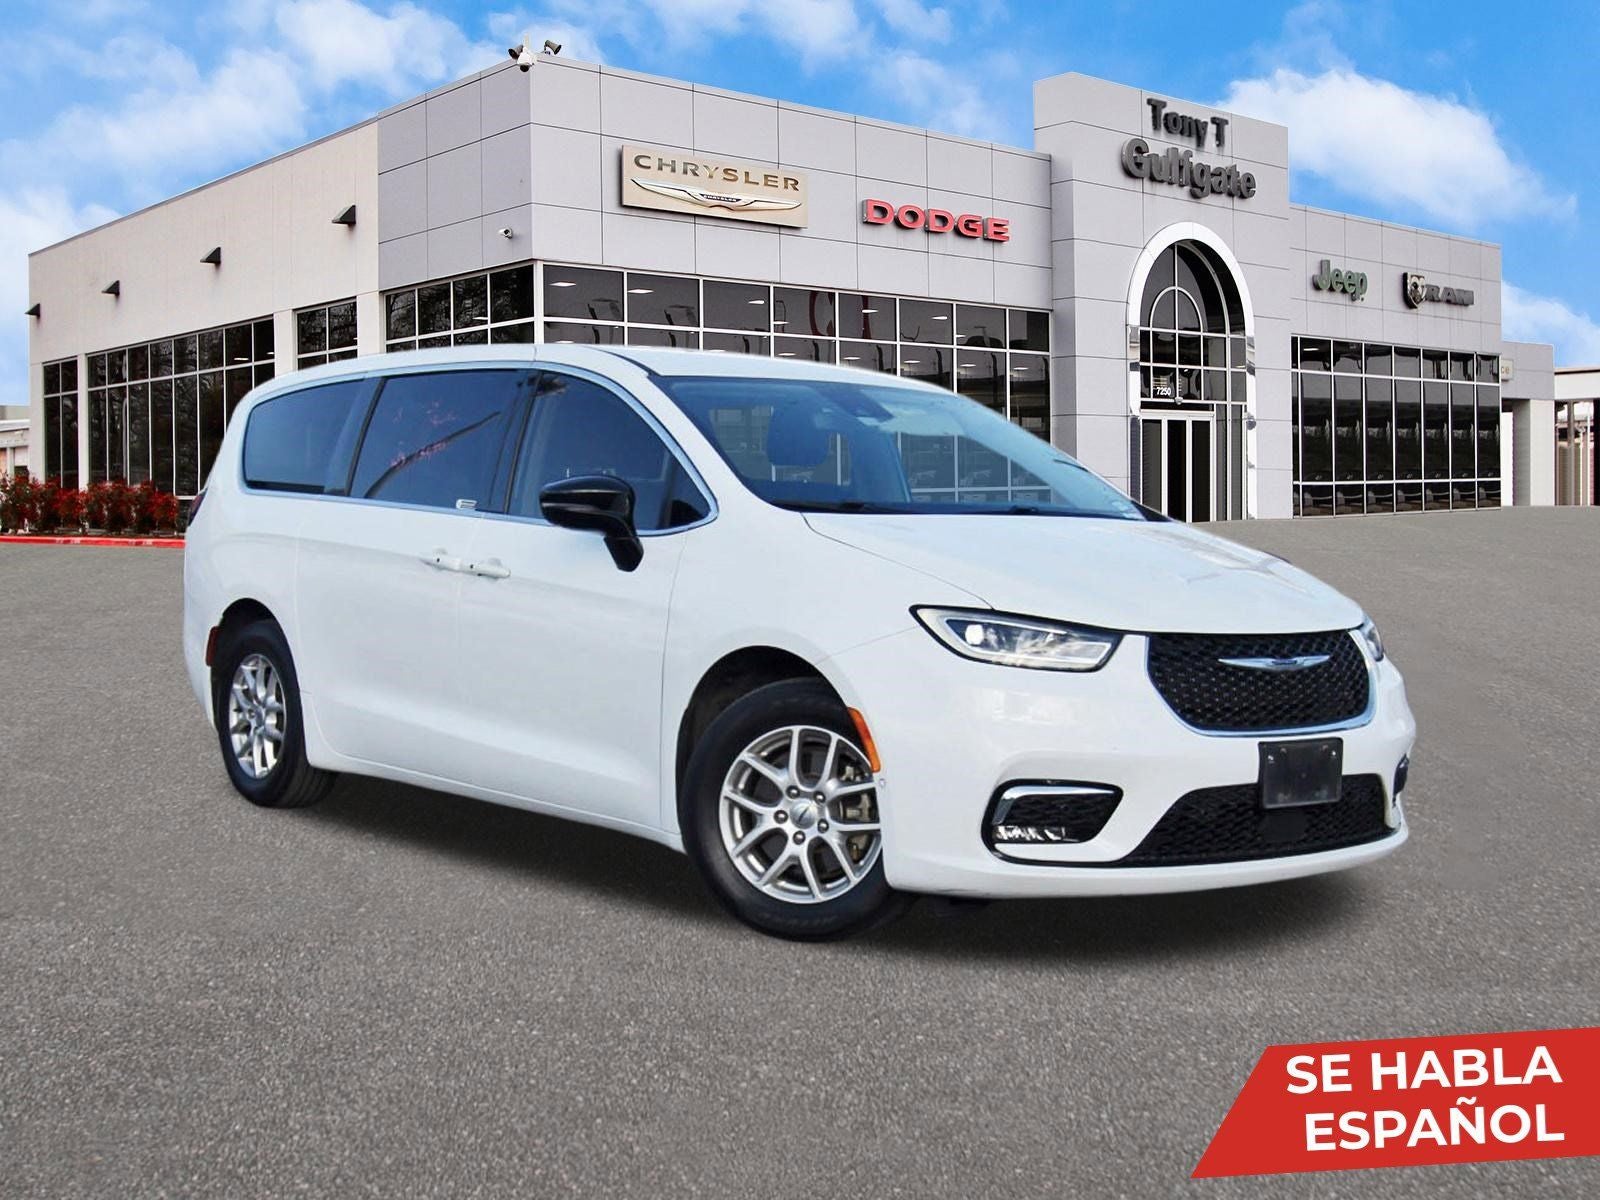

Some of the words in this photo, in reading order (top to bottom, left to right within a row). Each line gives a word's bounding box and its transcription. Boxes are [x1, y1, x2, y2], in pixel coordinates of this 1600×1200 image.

[1146, 97, 1208, 148] Tony
[1210, 116, 1229, 148] T
[633, 153, 800, 192] CHRYSLER
[1121, 138, 1257, 199] Gulfgate
[862, 198, 1009, 242] DODGE
[1312, 259, 1368, 302] Jeep
[1424, 283, 1475, 306] RAM
[1156, 386, 1171, 396] 7250
